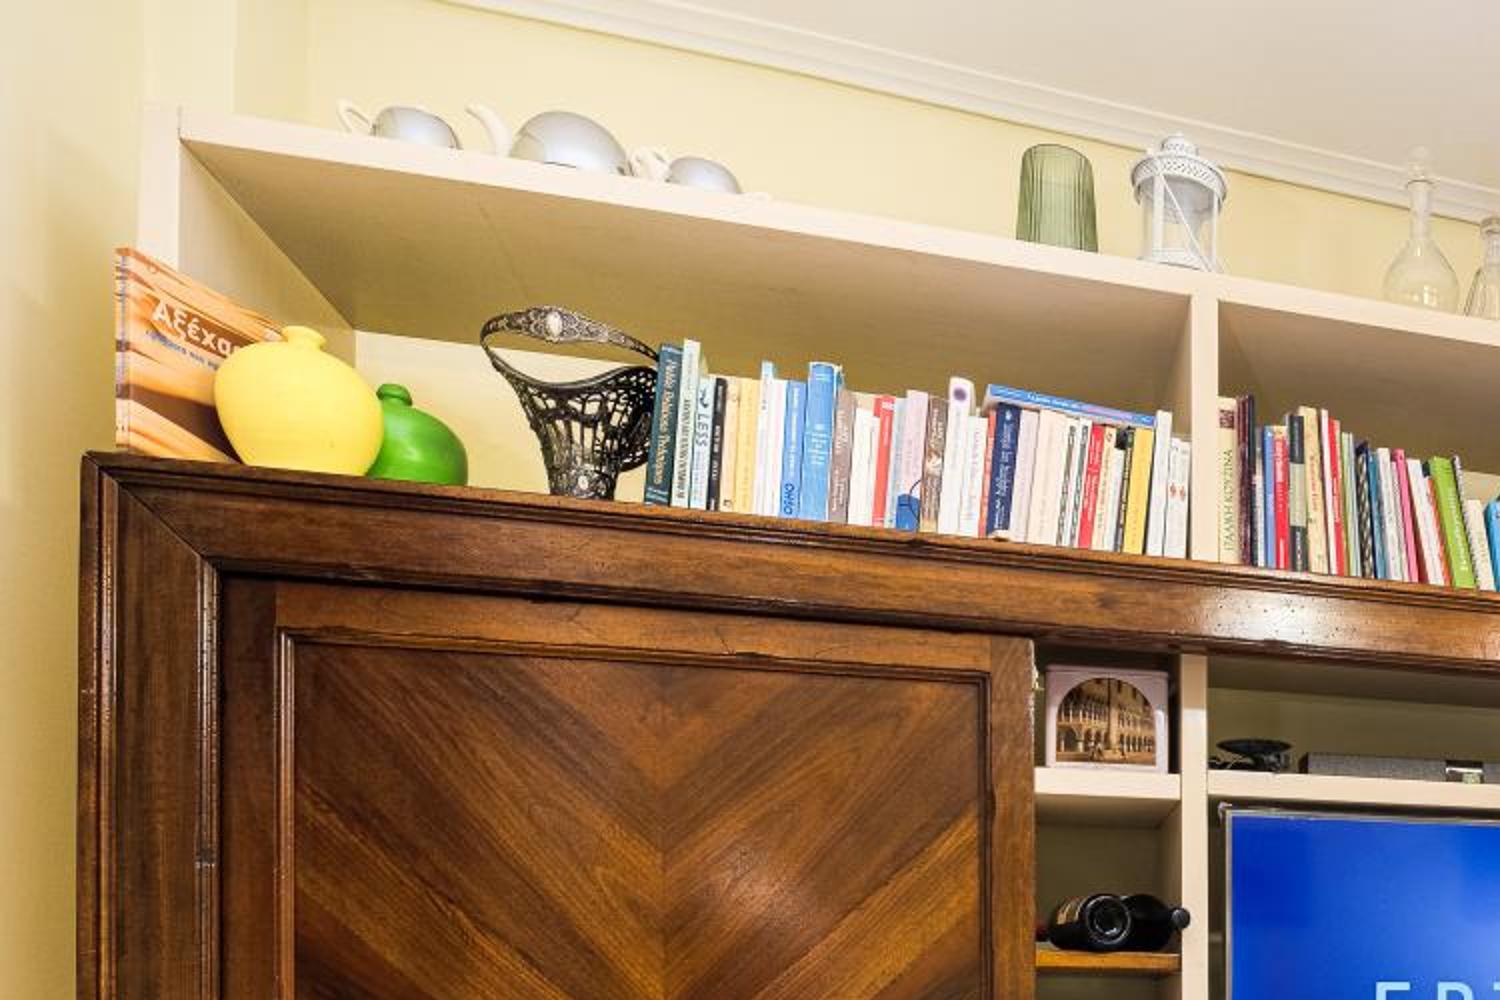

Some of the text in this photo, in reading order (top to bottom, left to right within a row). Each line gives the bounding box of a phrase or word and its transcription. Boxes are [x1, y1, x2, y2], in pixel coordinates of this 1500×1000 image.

[151, 300, 242, 356] Αξέχα
[696, 412, 710, 448] LESS
[783, 482, 796, 516] OSHO
